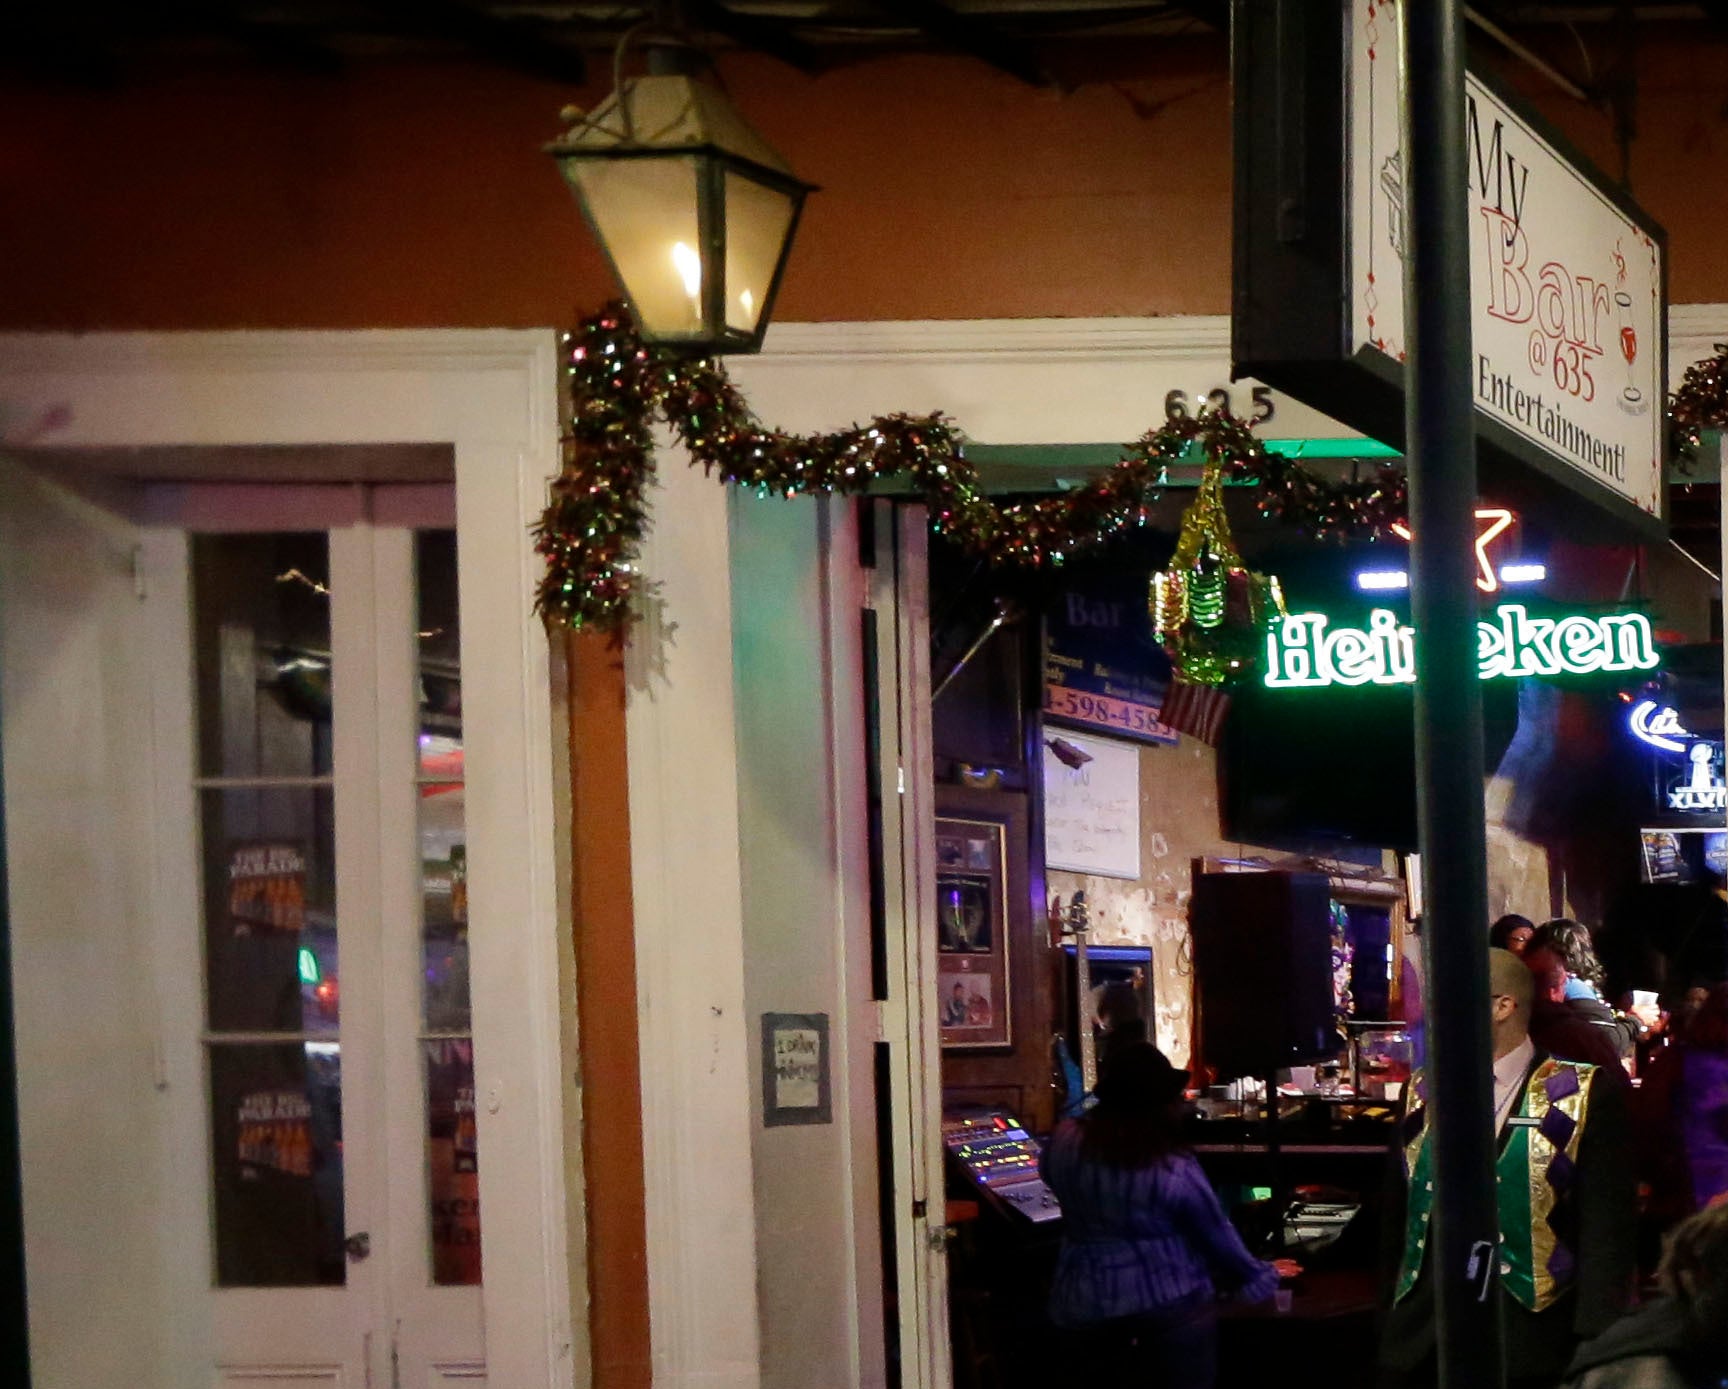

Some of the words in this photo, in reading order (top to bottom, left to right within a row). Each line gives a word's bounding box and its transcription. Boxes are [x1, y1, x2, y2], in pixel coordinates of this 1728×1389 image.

[1466, 94, 1530, 246] My
[1480, 206, 1610, 355] Bar
[1478, 354, 1626, 484] Entertainment!
[1528, 329, 1547, 376] @
[1553, 340, 1595, 402] 635
[1064, 591, 1127, 628] Bar
